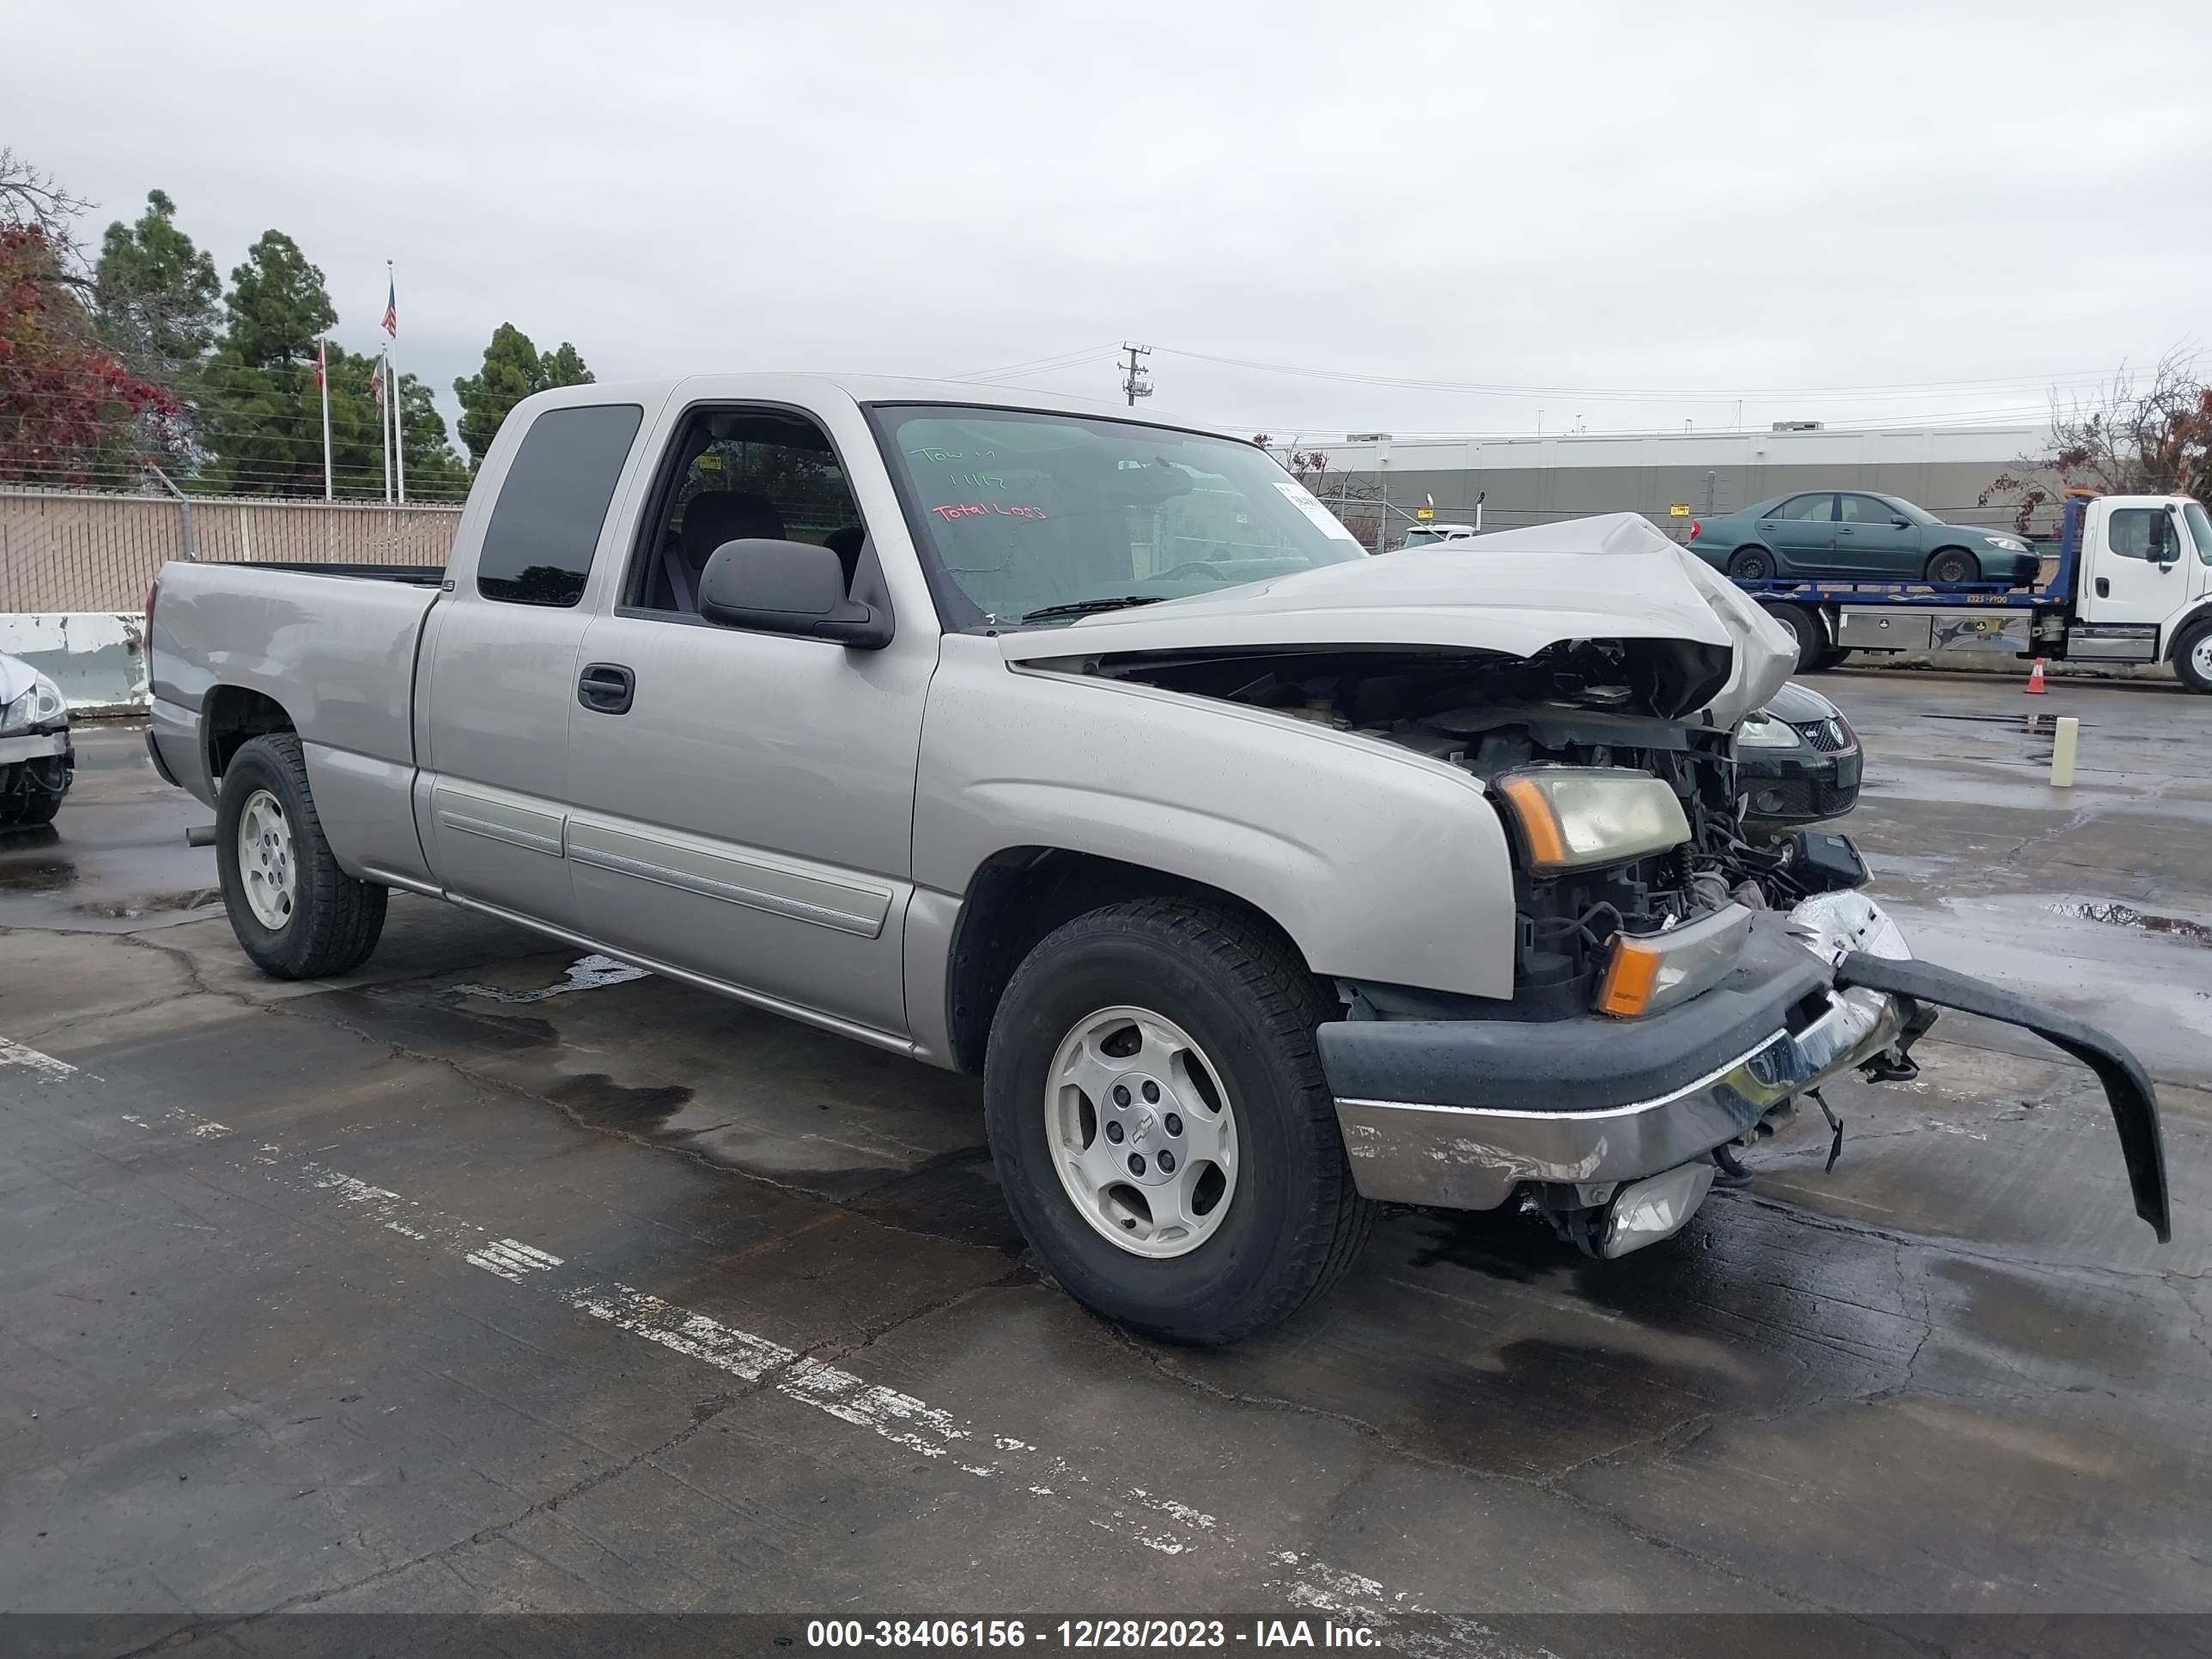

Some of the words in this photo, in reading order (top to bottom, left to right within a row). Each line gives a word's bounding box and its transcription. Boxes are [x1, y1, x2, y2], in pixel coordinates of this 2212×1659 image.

[908, 447, 963, 462] Tow
[933, 502, 990, 522] Total
[993, 503, 1047, 520] Loss
